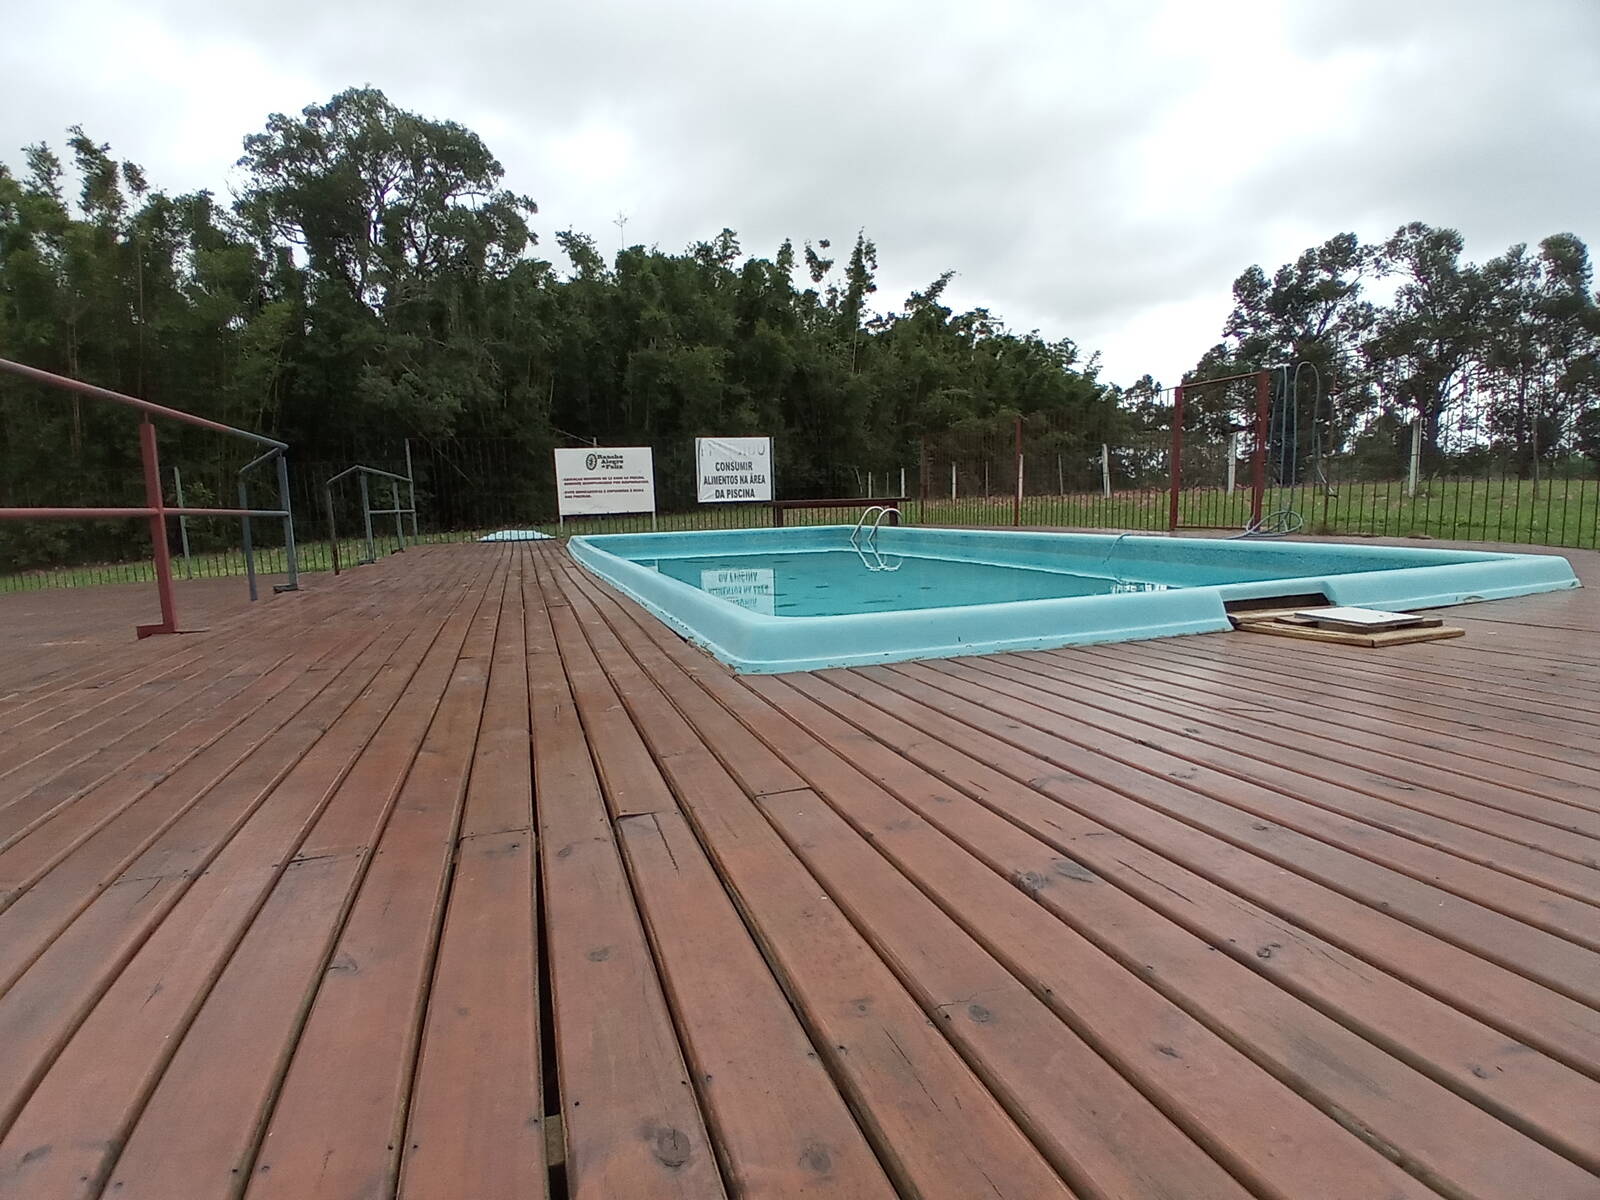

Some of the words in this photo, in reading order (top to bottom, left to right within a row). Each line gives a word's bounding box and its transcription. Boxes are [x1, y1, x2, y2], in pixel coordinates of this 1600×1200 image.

[715, 461, 753, 471] CONSUMIR
[704, 475, 739, 485] ALIMENTOS
[740, 475, 748, 484] NA
[750, 473, 766, 484] ÁREA
[715, 489, 725, 499] DA
[726, 488, 755, 499] PISCINA
